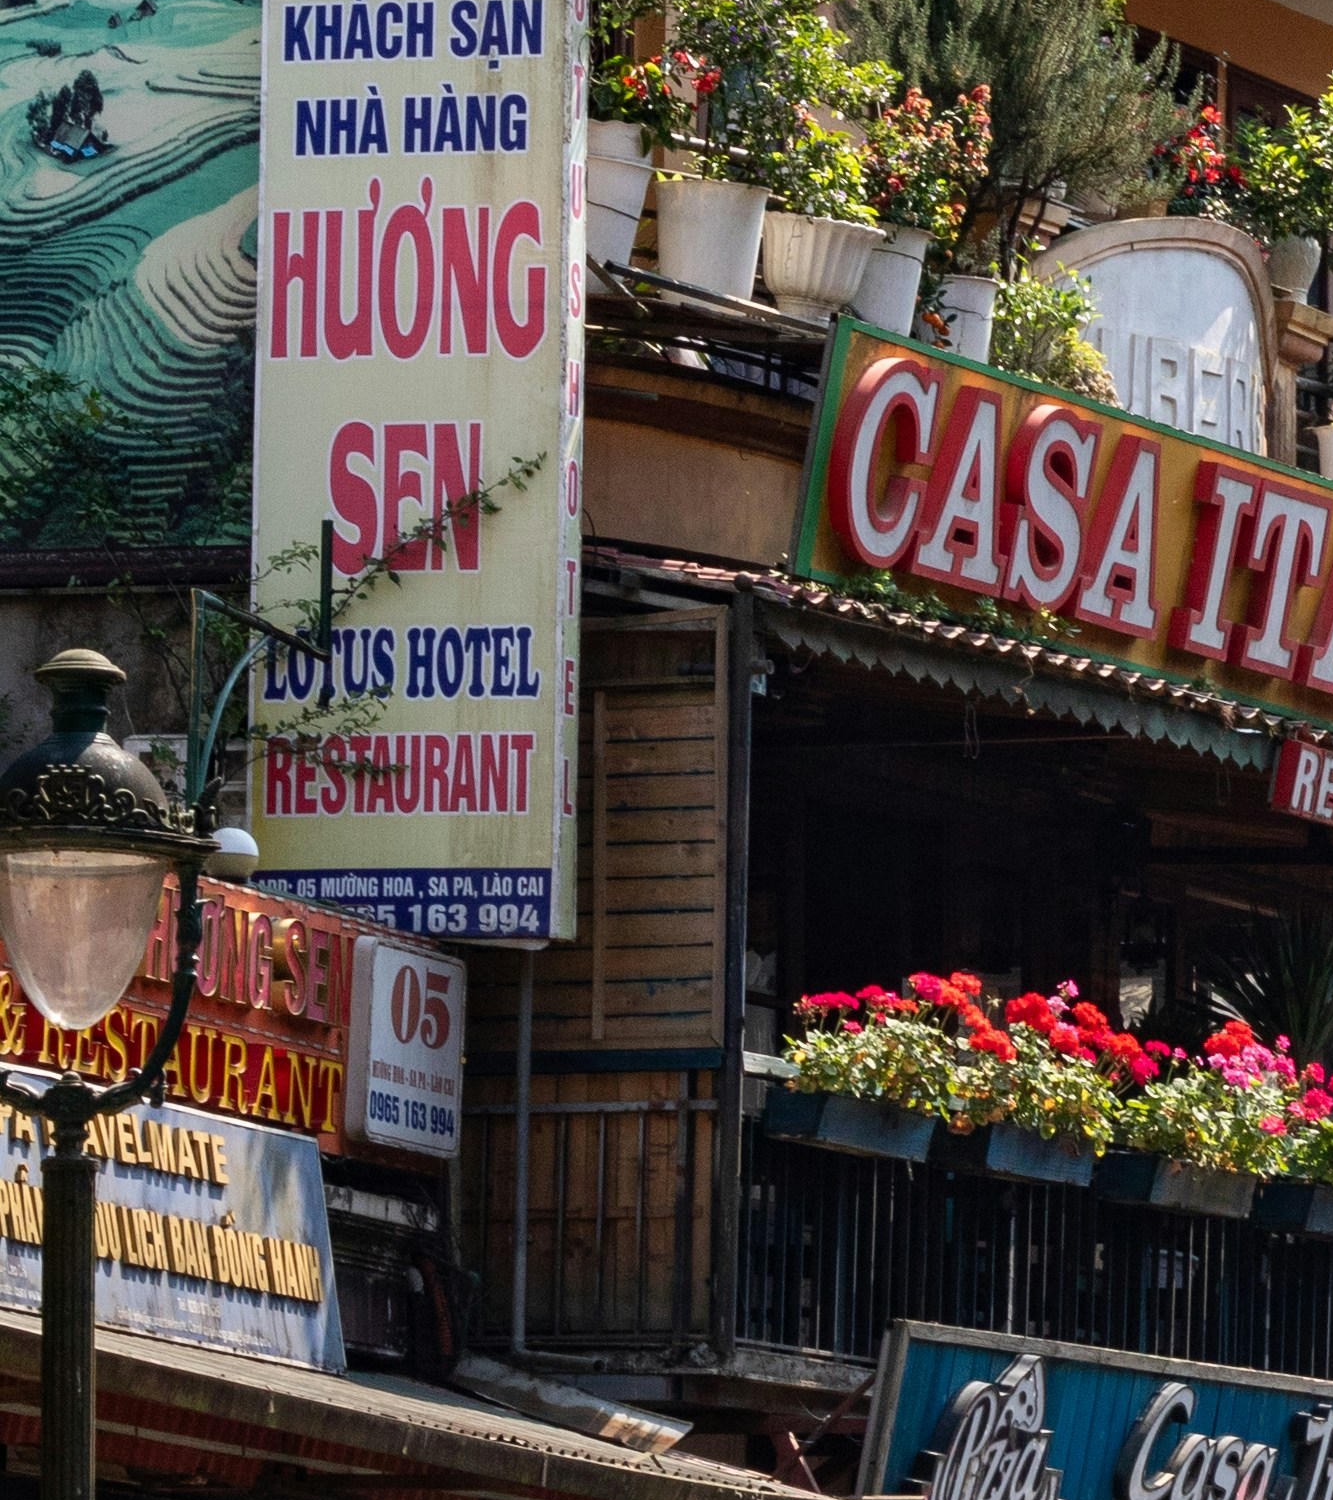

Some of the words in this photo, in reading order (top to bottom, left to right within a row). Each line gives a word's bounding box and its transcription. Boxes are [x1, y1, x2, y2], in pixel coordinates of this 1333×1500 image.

[295, 86, 380, 156] NHÀ
[404, 83, 527, 152] HÀNG
[270, 177, 547, 358] HƯƠNG
[329, 421, 482, 574] SEN
[832, 358, 1162, 640] CASA
[264, 625, 395, 700] LOTUS
[406, 625, 540, 700] HOTEL
[265, 734, 535, 815] RESTAURANT
[297, 878, 316, 897] 05
[320, 873, 378, 897] MƯỜNG
[383, 877, 414, 897] HOA
[428, 877, 448, 897] SA
[482, 872, 512, 897] LÀO
[517, 876, 544, 897] CAI
[408, 904, 468, 932] 163
[478, 904, 540, 933] 994
[283, 918, 356, 1025] SEN
[391, 964, 451, 1050] 05
[369, 1090, 400, 1126] 0965
[404, 1099, 427, 1133] 163
[430, 1106, 455, 1139] 994
